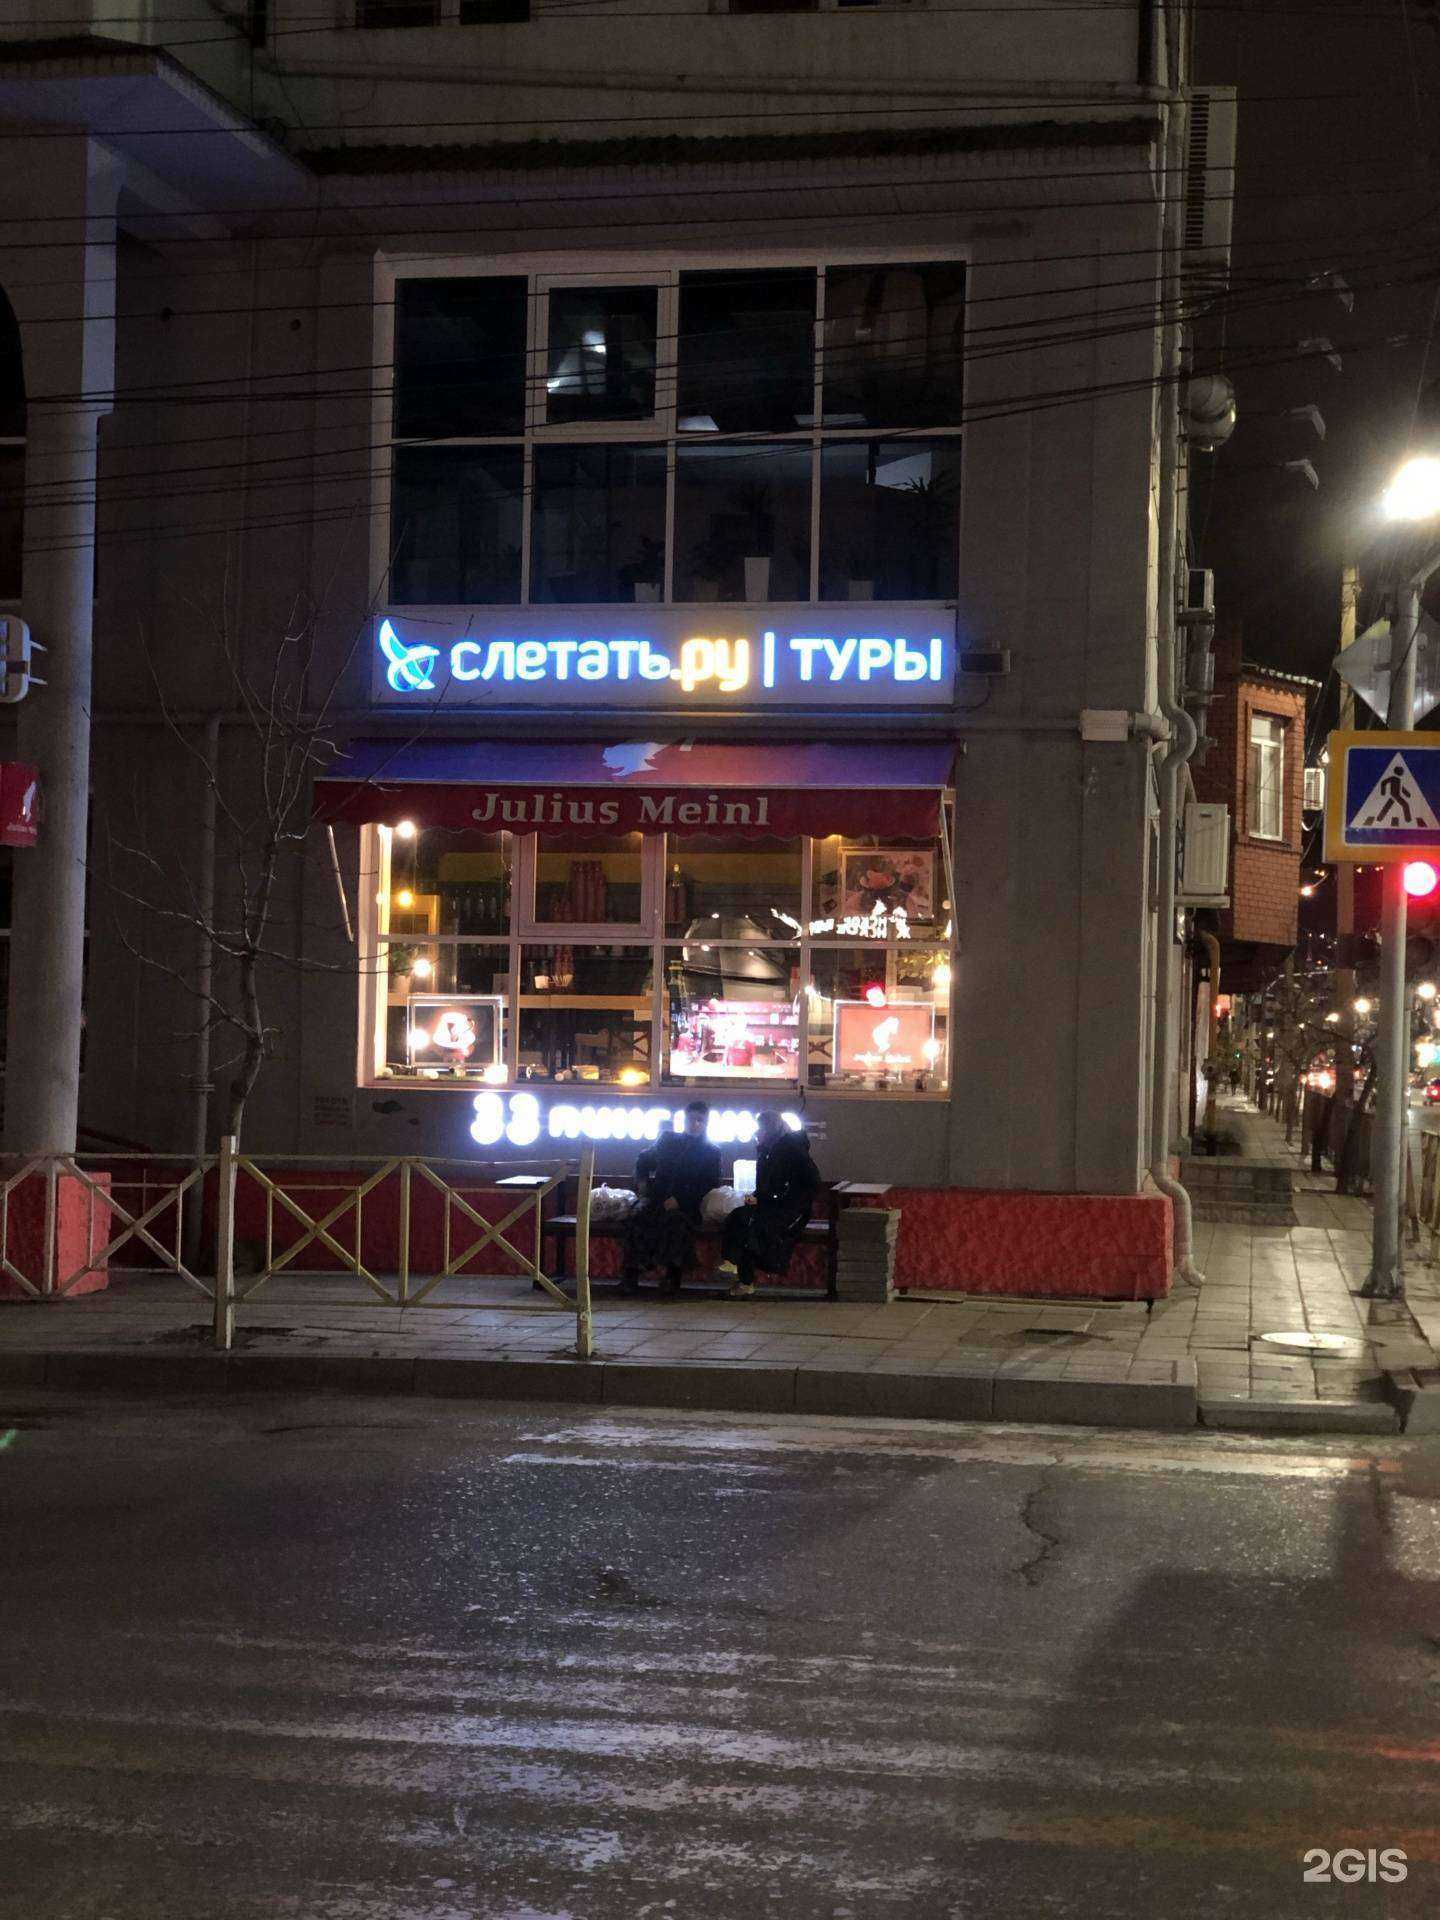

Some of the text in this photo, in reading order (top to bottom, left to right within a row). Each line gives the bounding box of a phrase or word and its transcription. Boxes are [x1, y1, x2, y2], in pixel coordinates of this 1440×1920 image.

[450, 636, 943, 693] слетать.ру ТУРЫ
[471, 793, 771, 826] Julius Meinl
